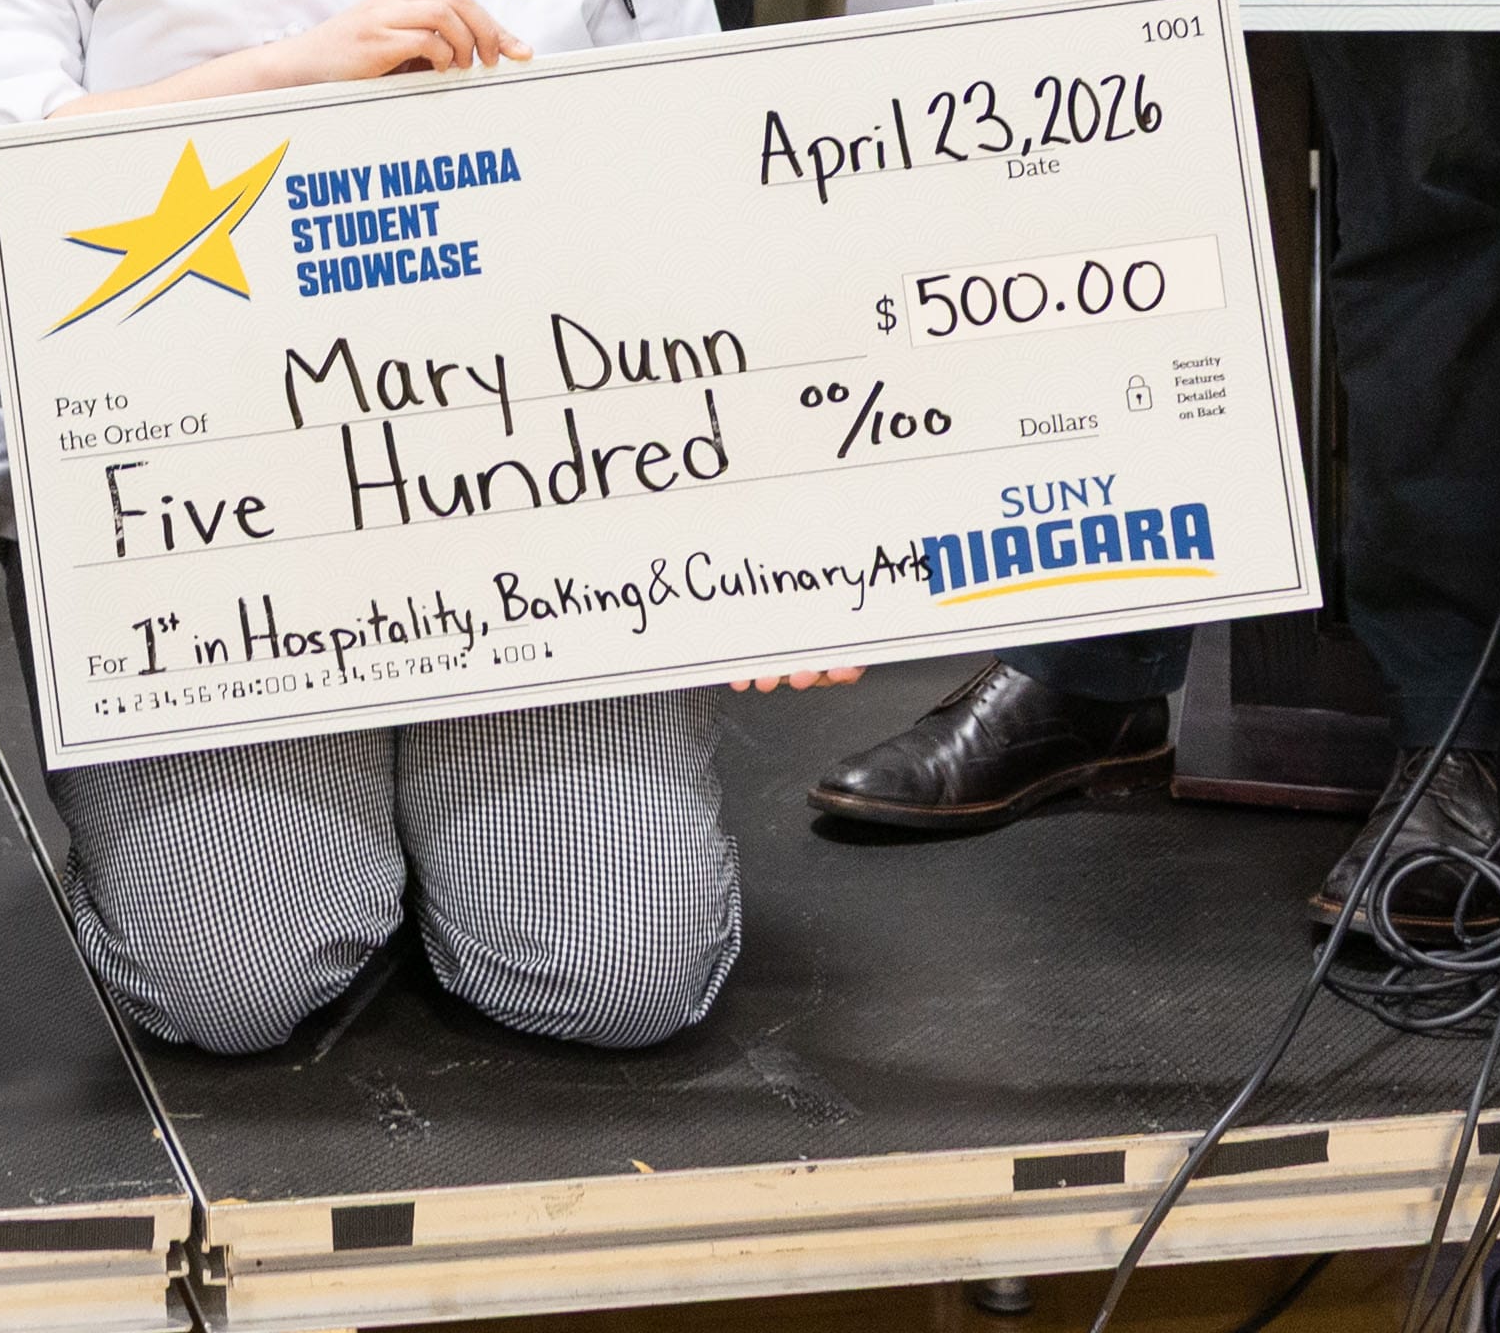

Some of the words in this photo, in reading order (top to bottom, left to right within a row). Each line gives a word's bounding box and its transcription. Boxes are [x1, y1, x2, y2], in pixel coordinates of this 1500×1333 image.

[1142, 17, 1205, 43] 1001
[760, 98, 912, 204] April
[1007, 156, 1061, 180] Date
[286, 167, 371, 210] SUNY
[379, 148, 521, 198] NIAGARA
[291, 201, 439, 254] STUDENT
[297, 240, 481, 298] SHOWCASE
[916, 260, 1166, 336] 500.00
[284, 337, 513, 438] Mary
[551, 313, 747, 394] Dunn
[55, 396, 99, 419] Pay
[104, 391, 129, 412] to
[1019, 412, 1100, 438] Dollars
[59, 429, 98, 452] the
[104, 418, 174, 446] Order
[179, 412, 210, 436] Of
[105, 461, 274, 558] Five
[341, 388, 729, 532] Hundred
[1001, 475, 1117, 519] SUNY
[922, 502, 1215, 596] NIAGARA
[88, 652, 128, 676] For
